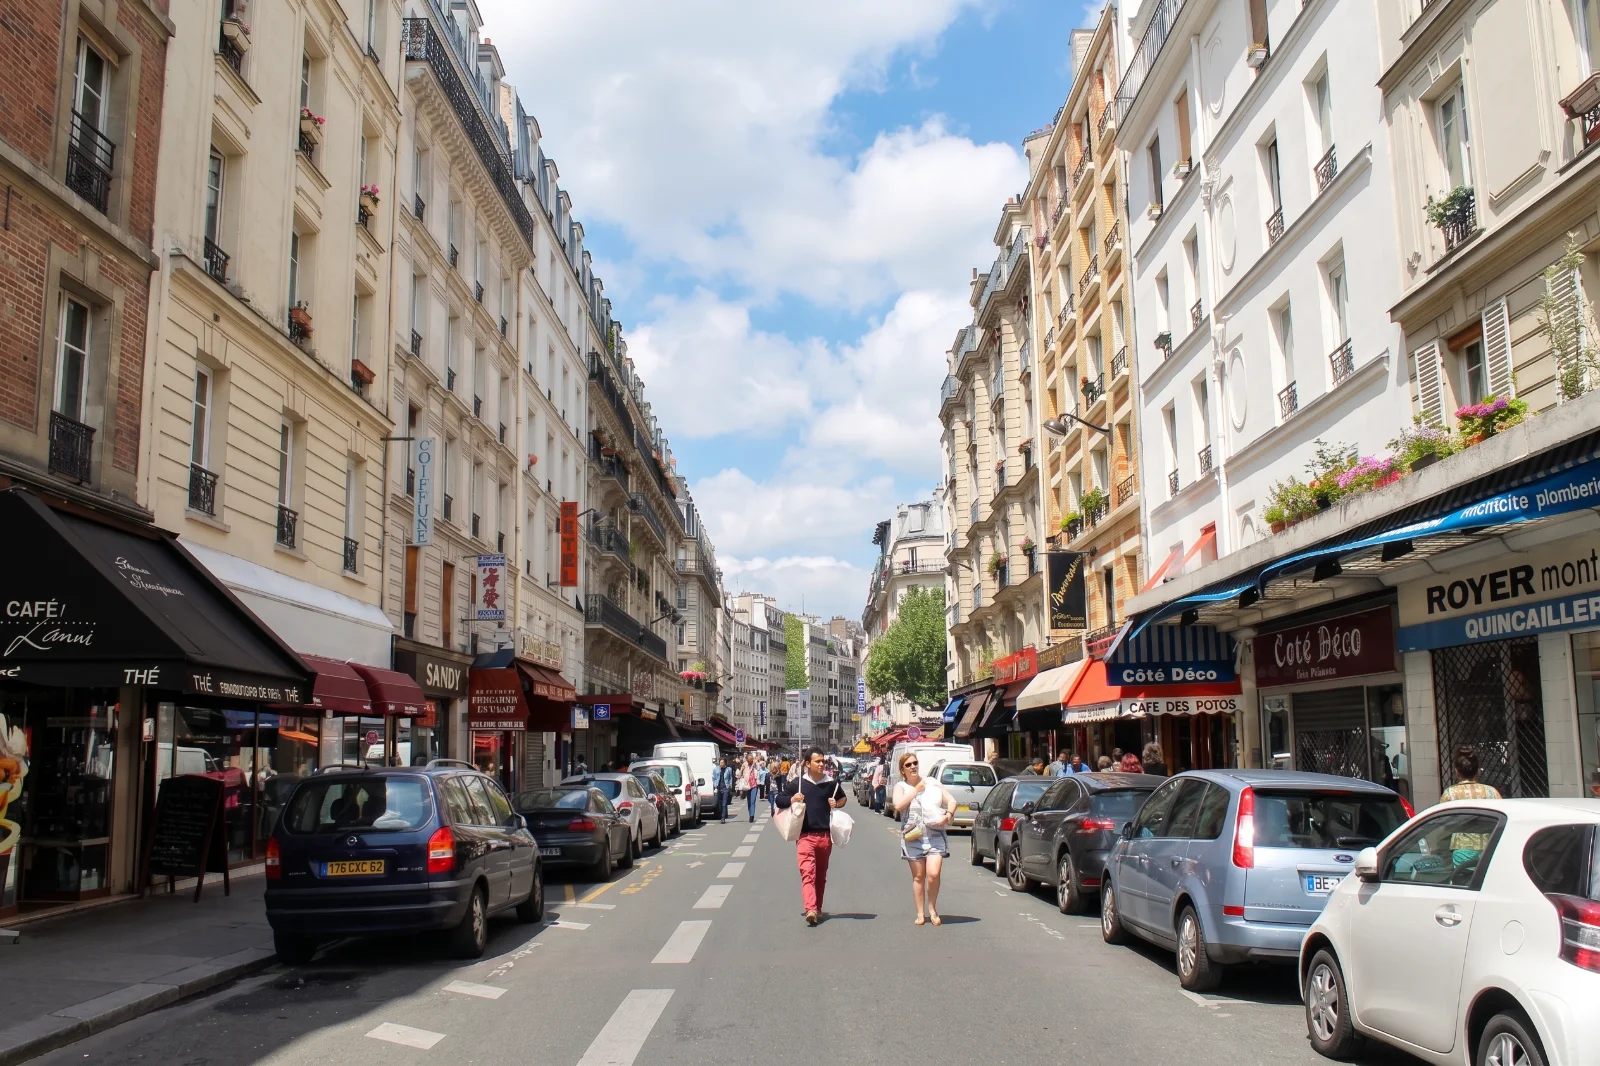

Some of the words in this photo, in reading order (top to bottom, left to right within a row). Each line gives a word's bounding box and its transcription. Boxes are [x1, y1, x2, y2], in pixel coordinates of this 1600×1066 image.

[1536, 477, 1600, 511] plomberi
[1426, 564, 1536, 615] ROYER
[1317, 626, 1361, 663] Déco
[123, 665, 160, 685] THÉ
[193, 672, 213, 692] THÉ
[284, 686, 299, 702] THÉ
[426, 662, 461, 691] SANDY
[1122, 668, 1165, 683] Côté
[1171, 667, 1217, 681] Déco
[1129, 701, 1160, 713] CAFE
[1166, 701, 1190, 712] DES
[1196, 699, 1237, 711] POTOS
[328, 863, 347, 874] 176
[348, 862, 367, 873] CXC
[370, 861, 383, 872] 62
